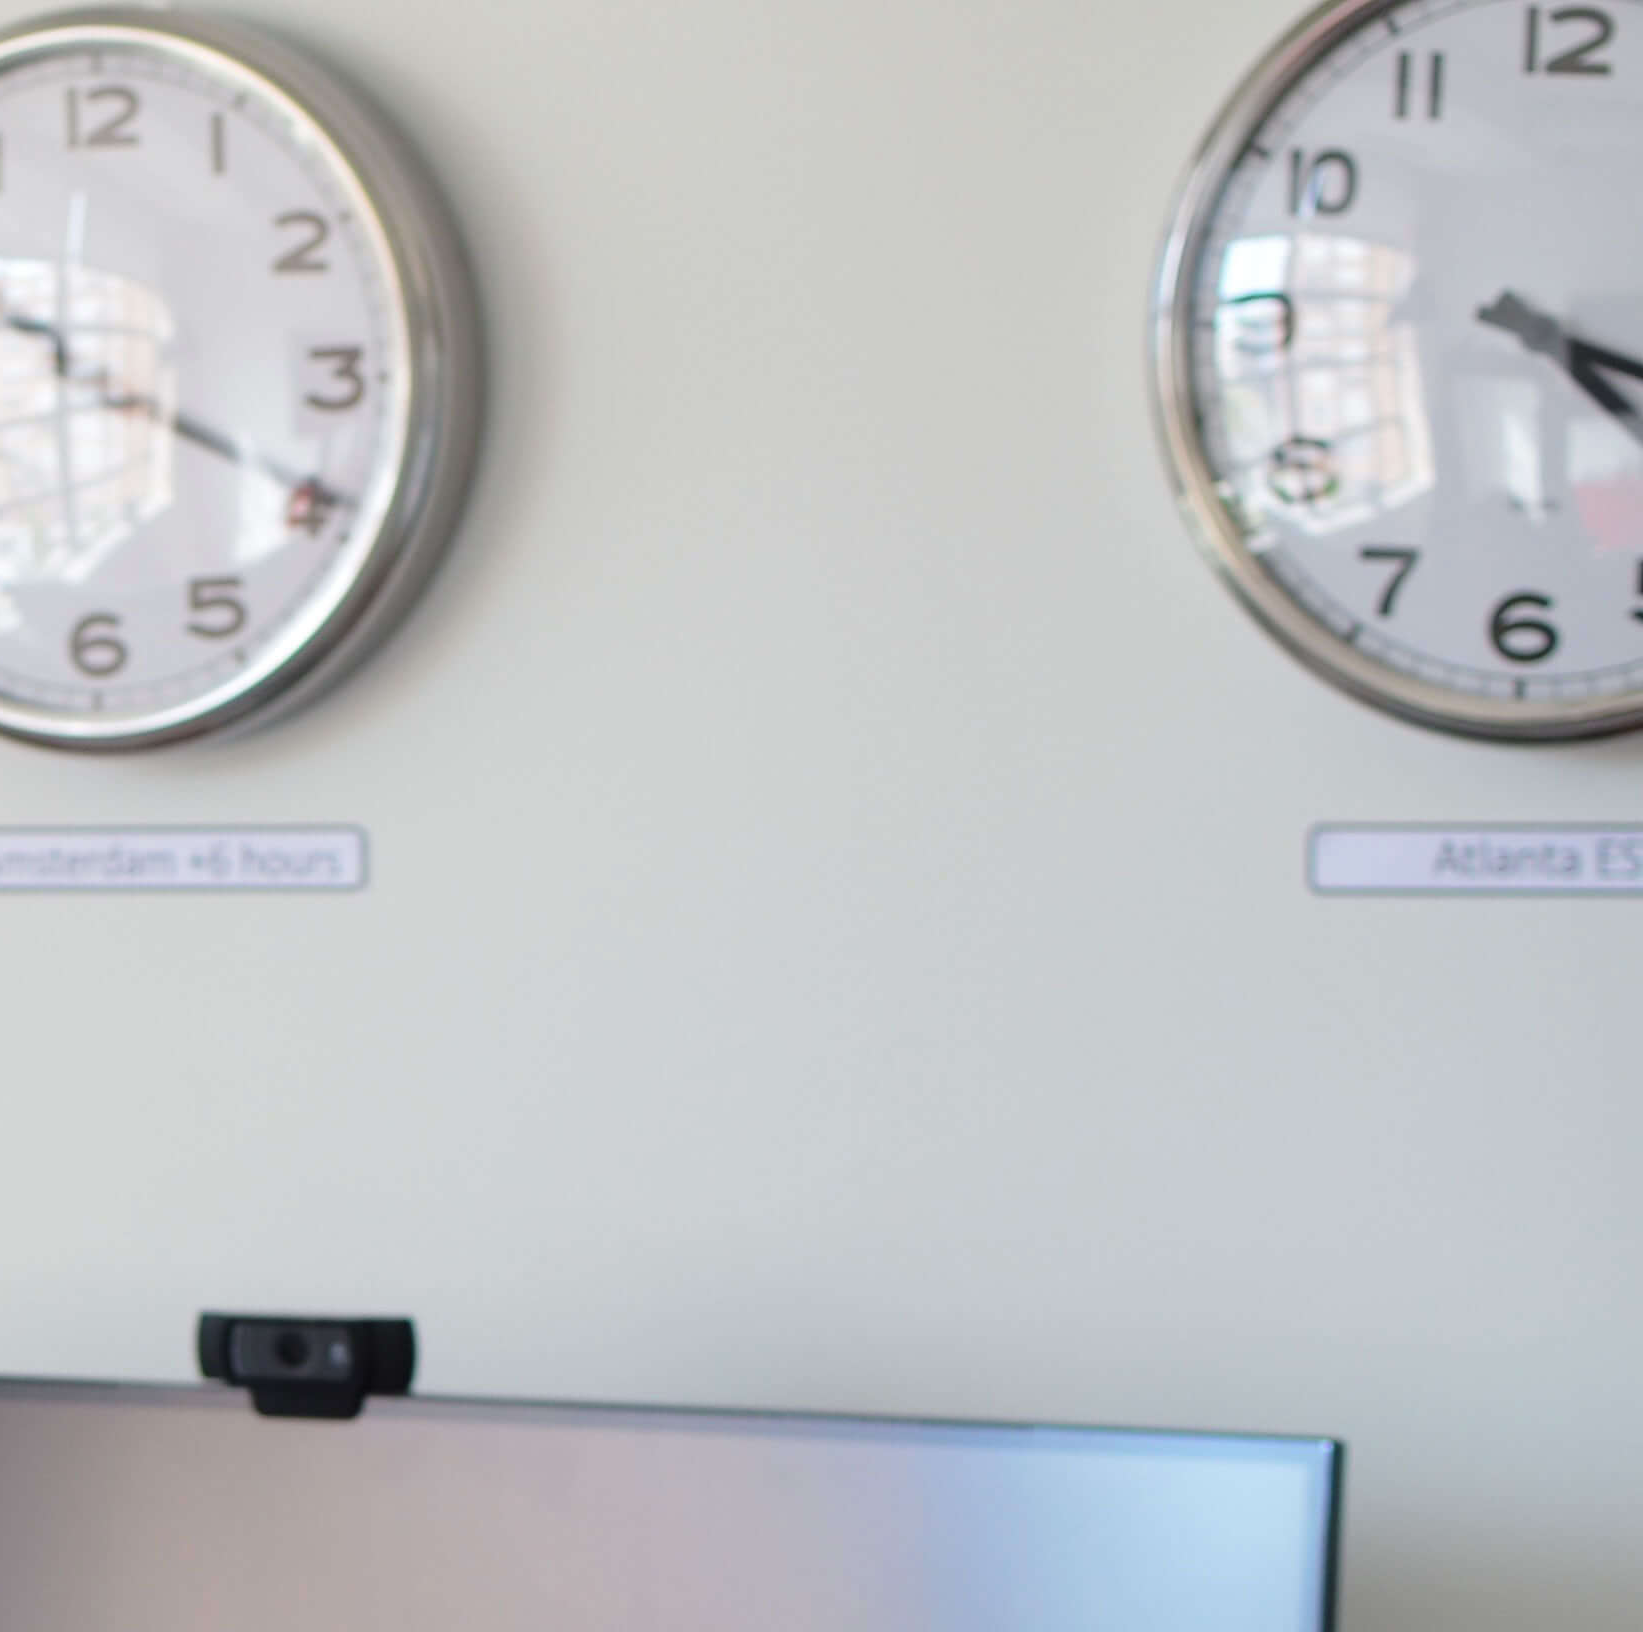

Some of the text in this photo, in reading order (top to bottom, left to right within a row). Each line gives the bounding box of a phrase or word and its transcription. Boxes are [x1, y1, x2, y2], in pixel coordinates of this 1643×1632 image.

[1523, 6, 1617, 76] 12
[65, 86, 141, 148] 12
[1393, 50, 1445, 121] 11
[211, 114, 226, 176] 1
[1288, 147, 1359, 216] 10
[272, 211, 331, 273] 2
[305, 346, 366, 413] 3
[186, 576, 248, 639] 5
[1357, 545, 1421, 617] 7
[69, 613, 129, 678] 6
[1488, 591, 1559, 663] 6
[236, 842, 342, 879] hours
[1433, 838, 1583, 879] Atlanta
